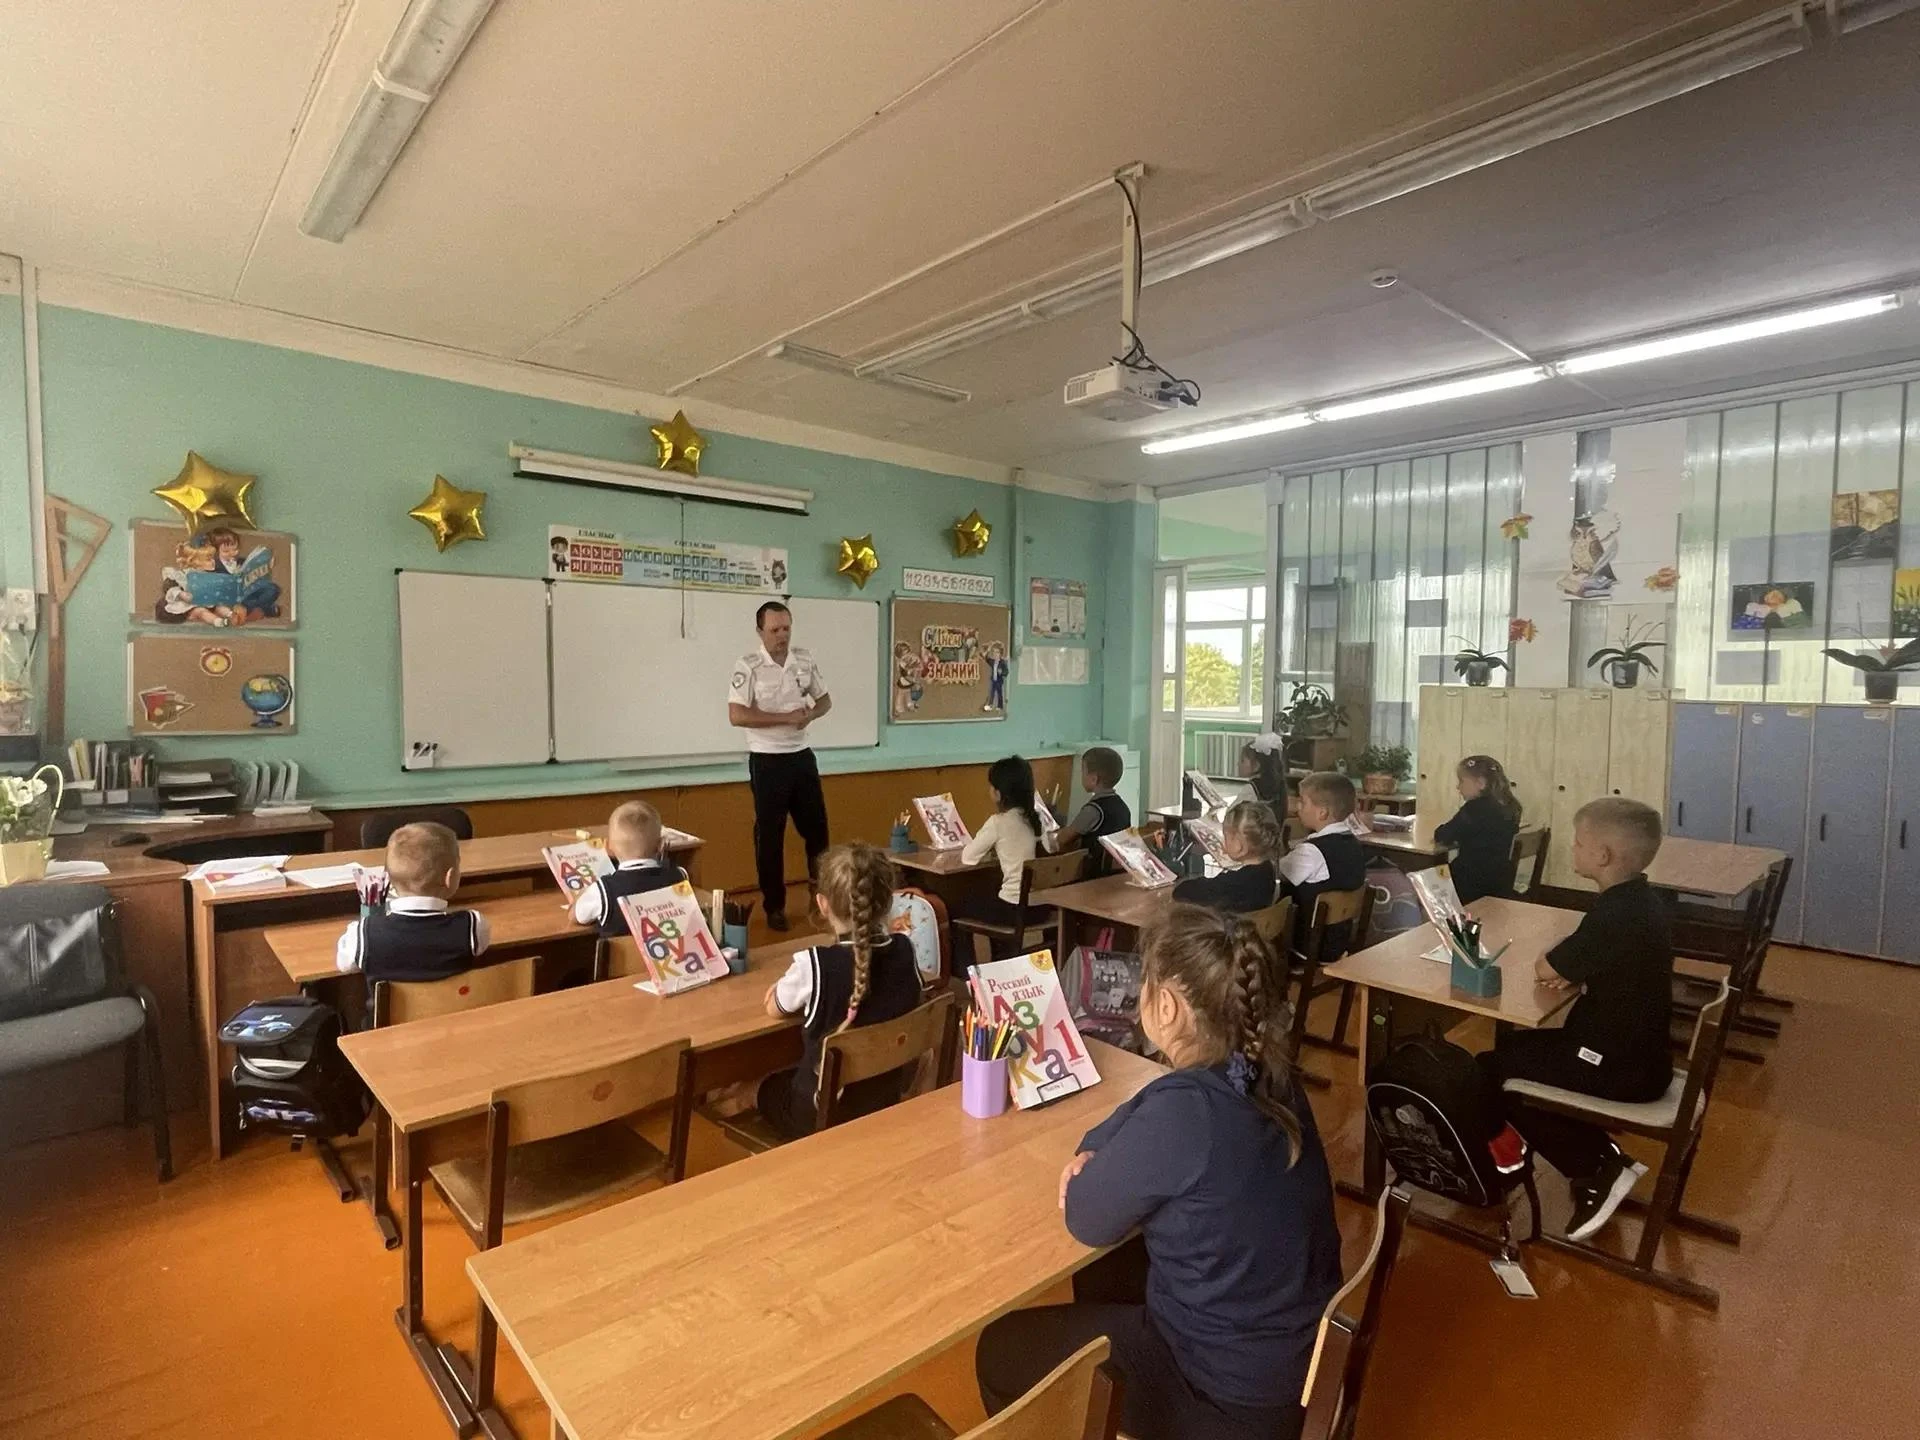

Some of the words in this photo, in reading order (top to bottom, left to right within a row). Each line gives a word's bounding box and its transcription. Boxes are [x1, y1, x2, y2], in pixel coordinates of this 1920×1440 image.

[694, 930, 717, 960] 1
[987, 975, 1032, 994] Русский
[1054, 1019, 1085, 1062] 1
